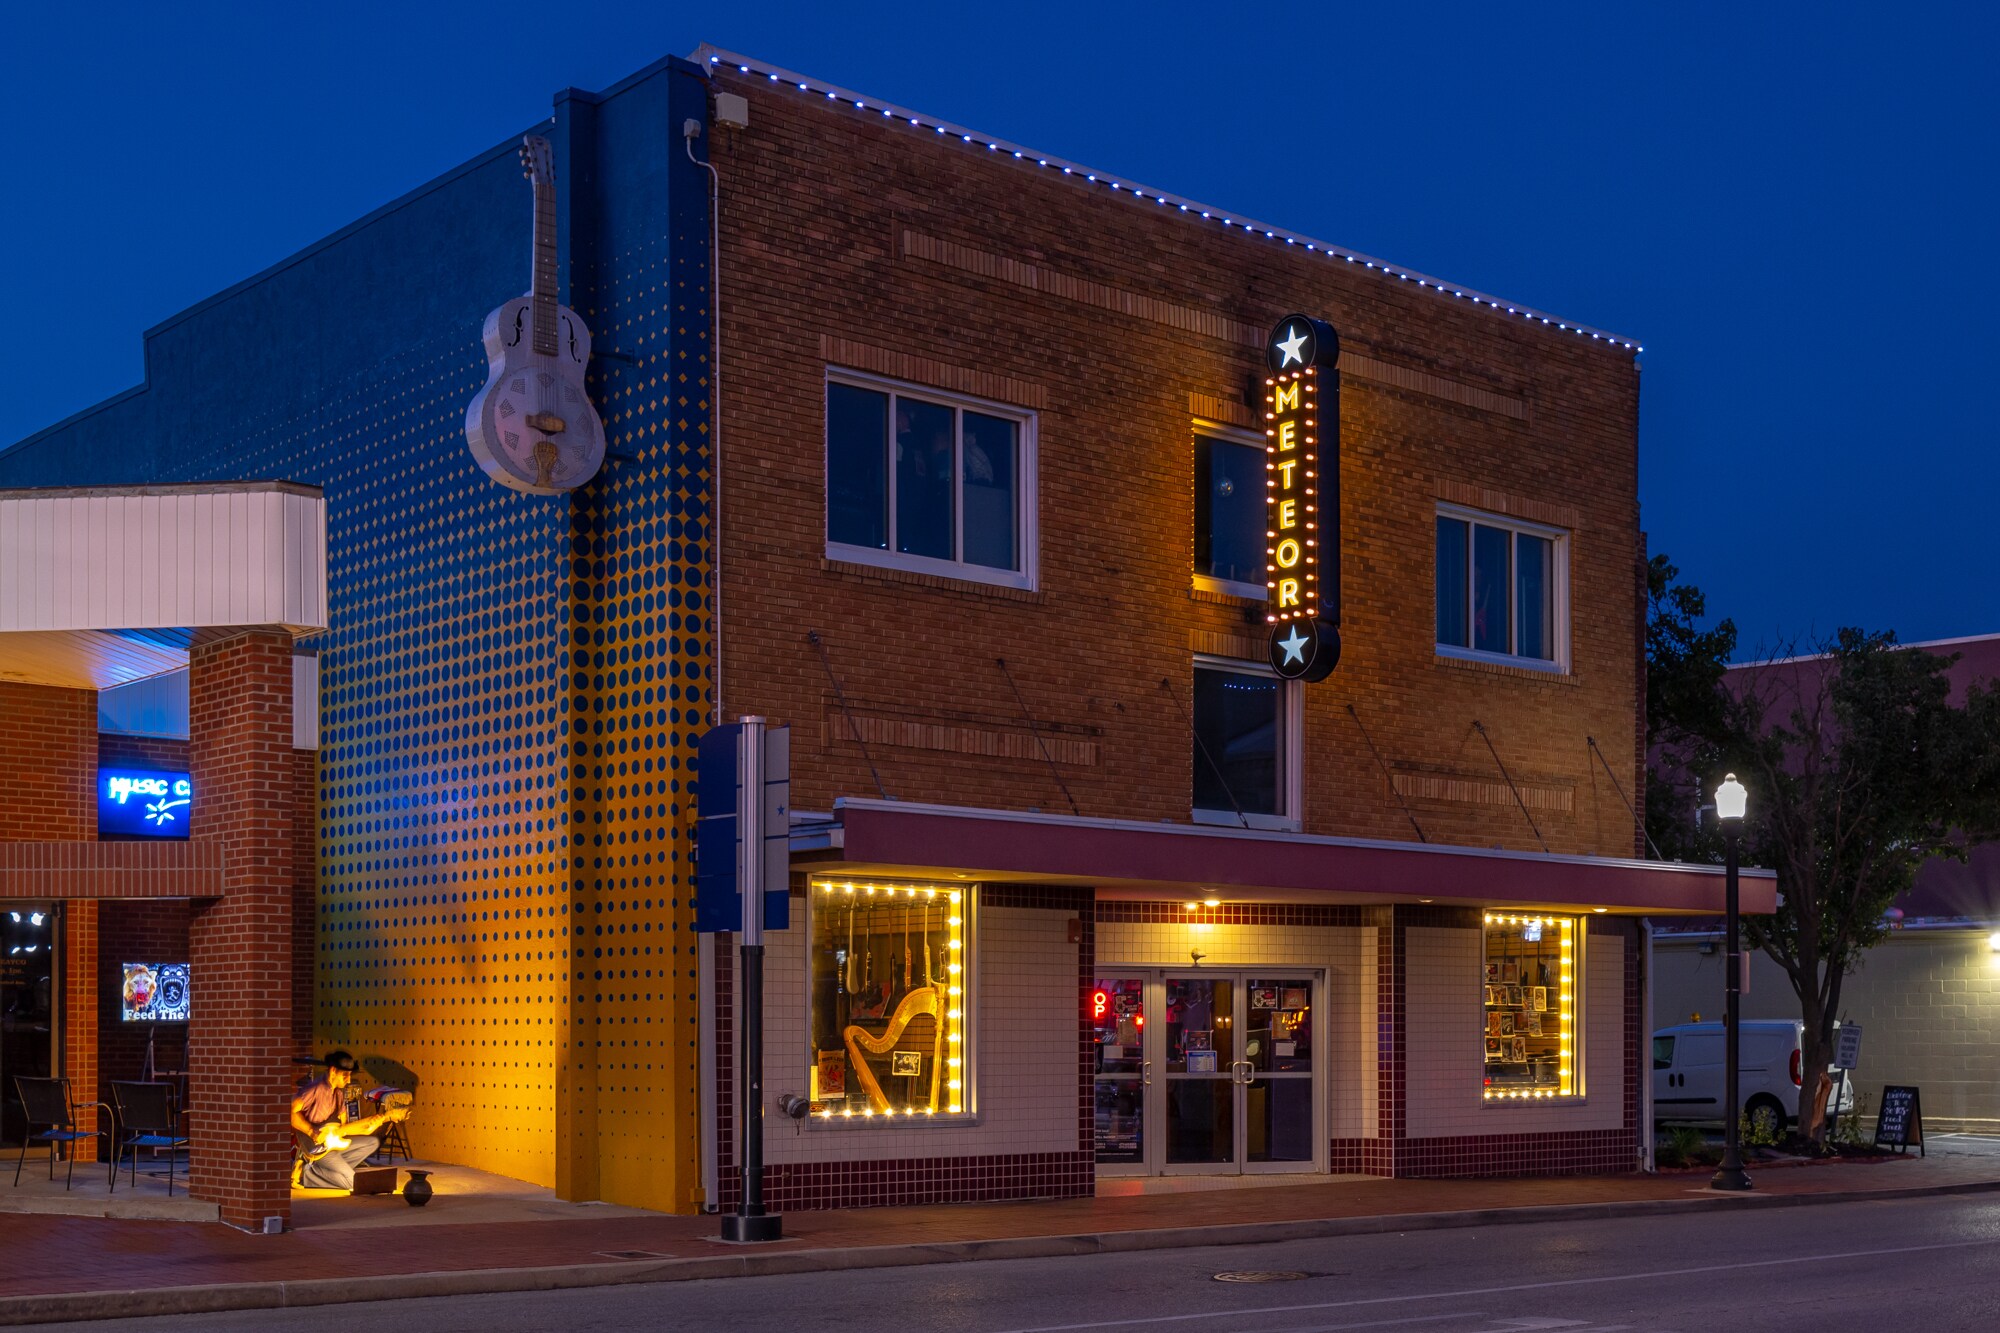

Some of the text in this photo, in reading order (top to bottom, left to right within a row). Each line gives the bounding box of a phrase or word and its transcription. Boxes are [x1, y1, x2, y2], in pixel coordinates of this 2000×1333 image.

[1275, 380, 1300, 608] METEOR
[125, 1009, 156, 1020] Feed
[159, 1009, 184, 1020] The
